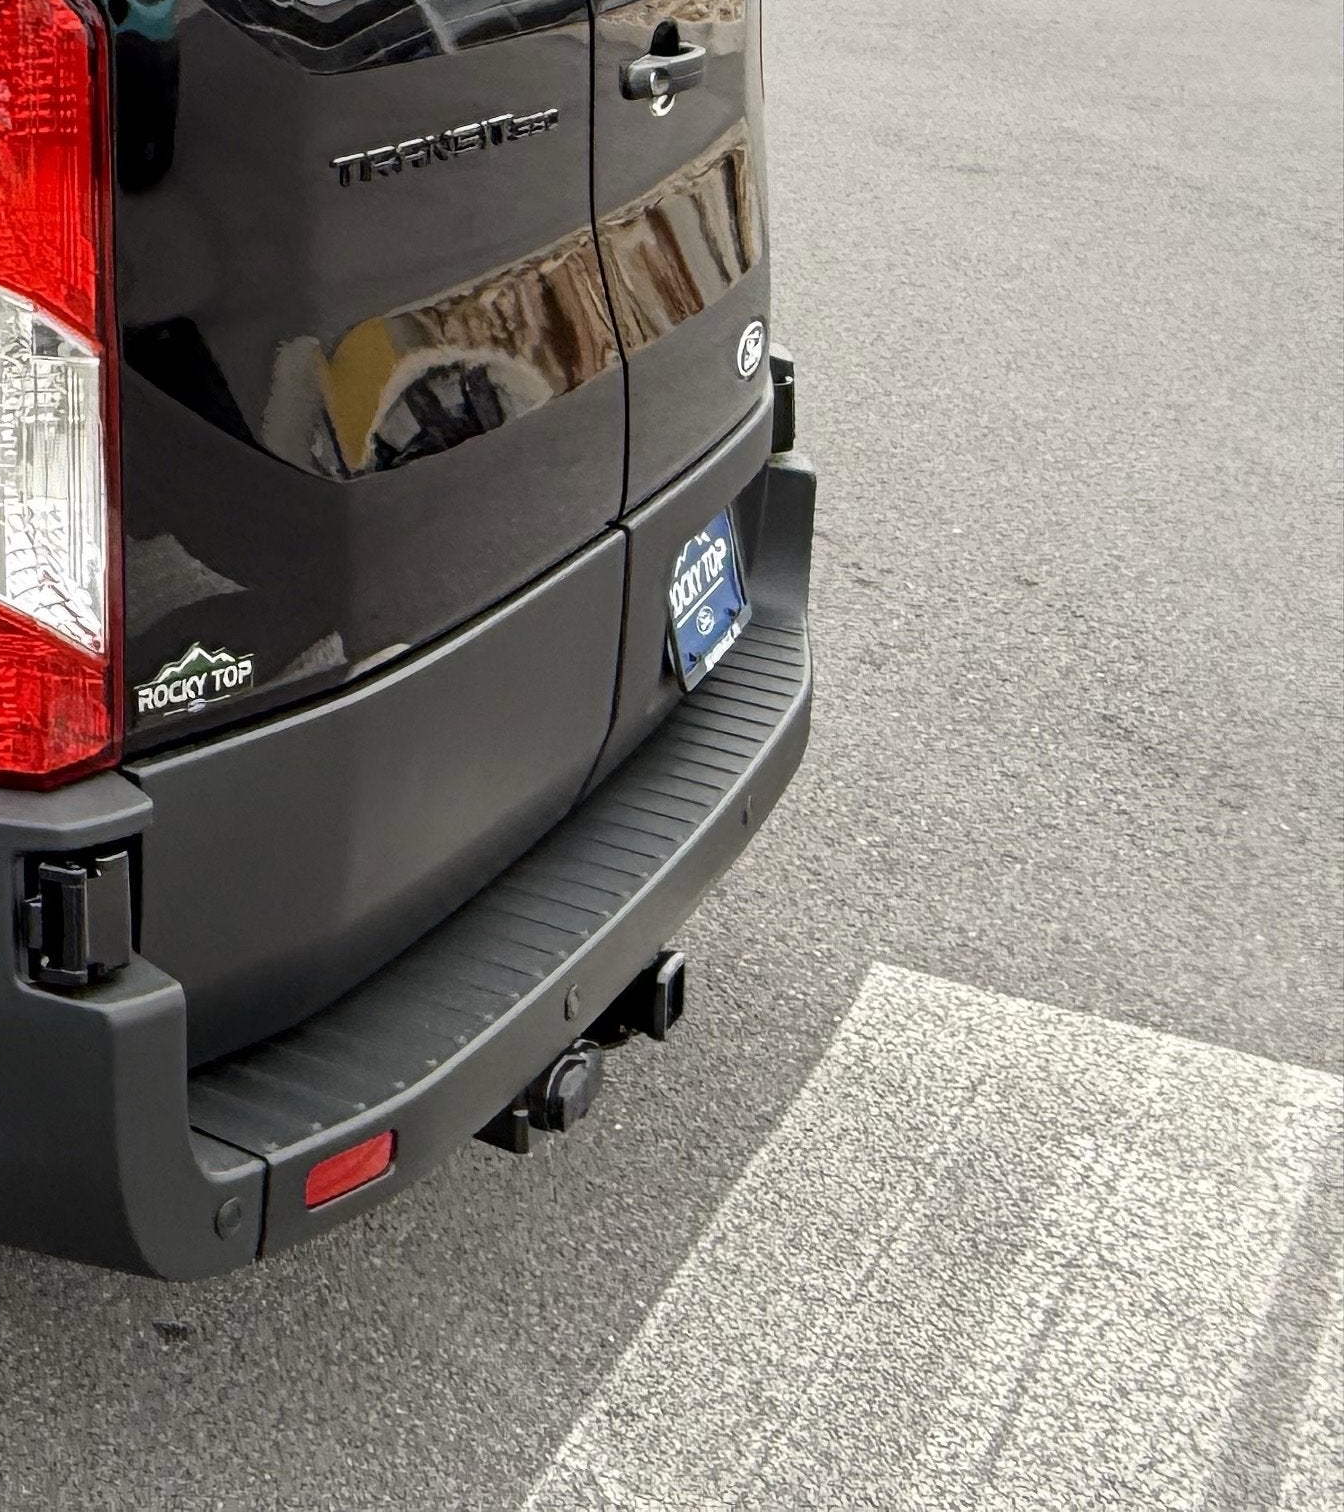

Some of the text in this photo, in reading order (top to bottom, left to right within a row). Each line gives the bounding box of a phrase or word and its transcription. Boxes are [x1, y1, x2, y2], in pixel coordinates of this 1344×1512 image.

[701, 537, 727, 584] TOP
[138, 672, 208, 713] ROCKY
[211, 659, 252, 692] TOP
